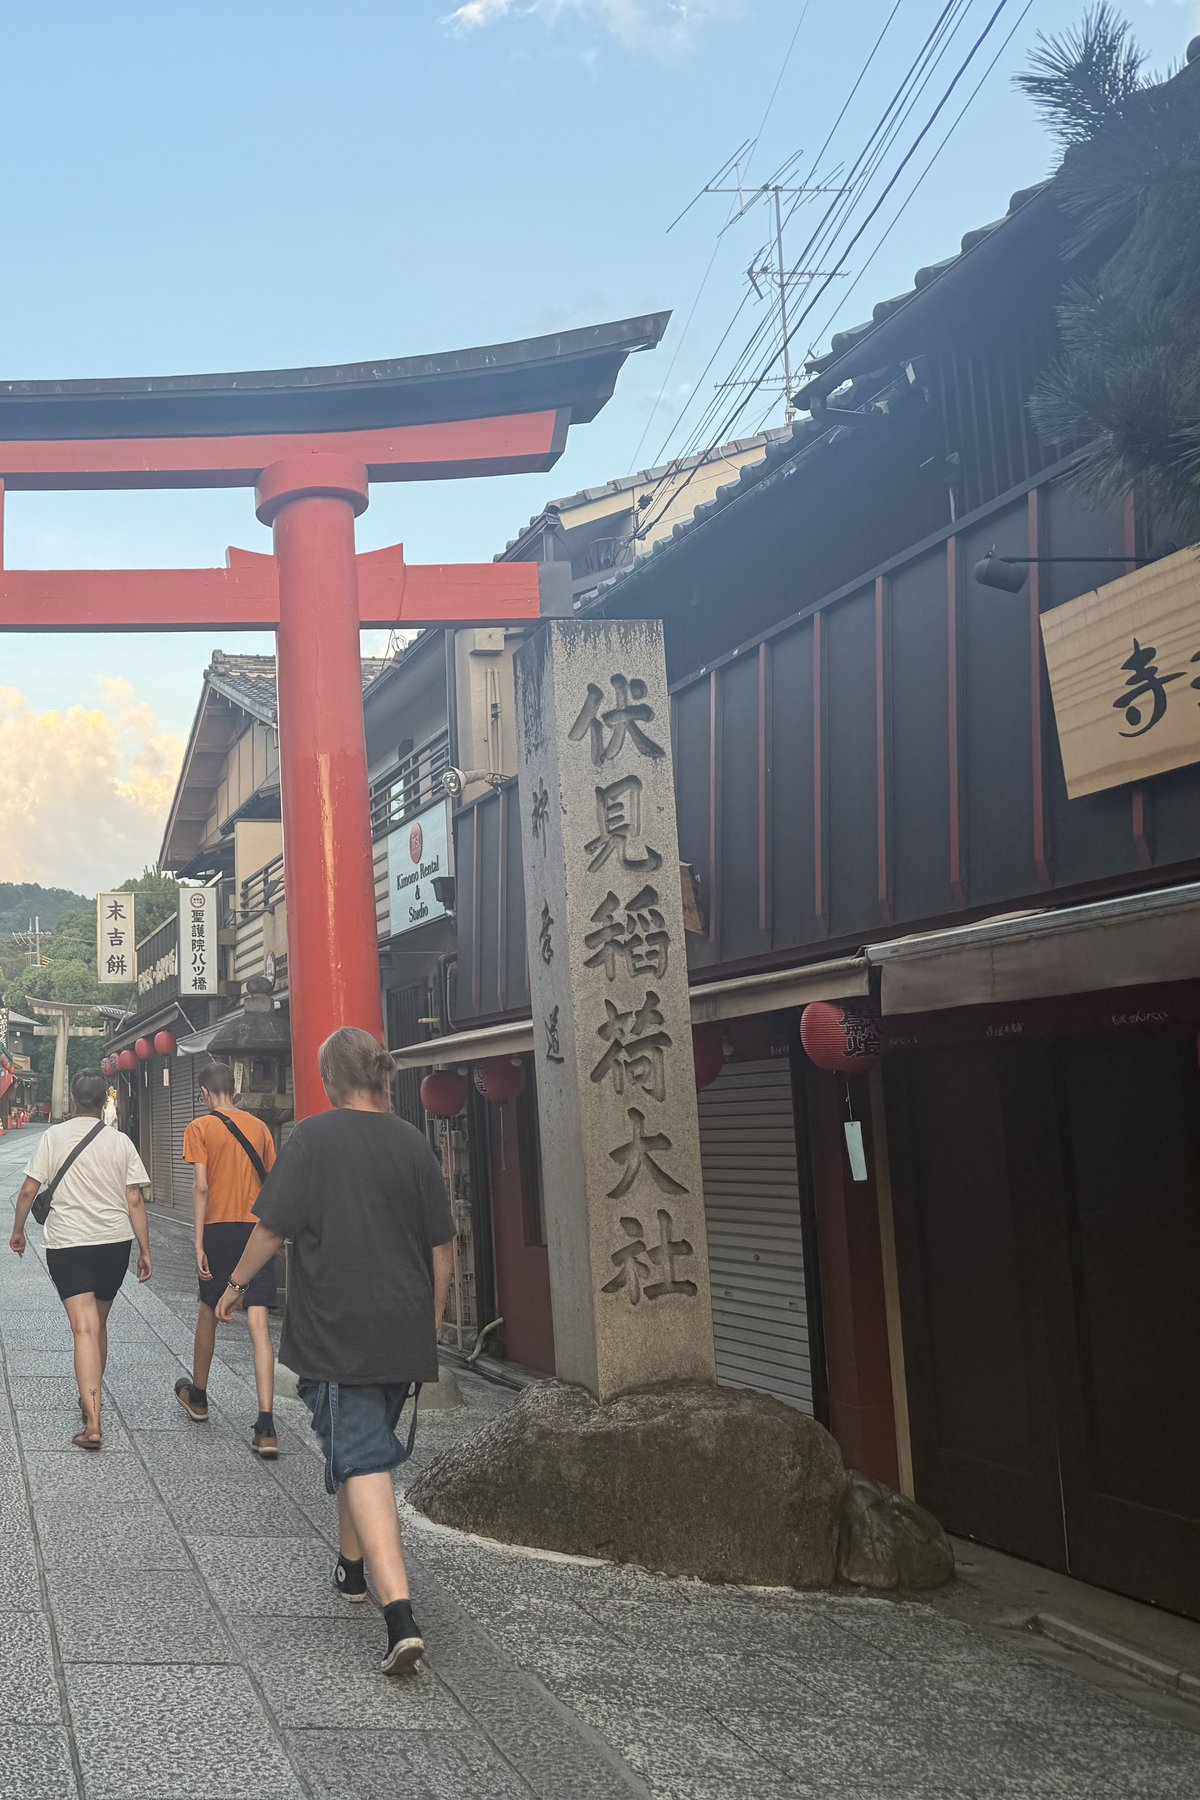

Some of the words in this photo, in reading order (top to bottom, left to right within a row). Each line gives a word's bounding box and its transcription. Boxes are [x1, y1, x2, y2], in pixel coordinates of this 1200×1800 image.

[397, 871, 420, 890] Kimono
[420, 855, 440, 879] Rental
[415, 884, 421, 901] &
[408, 901, 429, 923] Studio
[106, 900, 127, 976] 末吉餅
